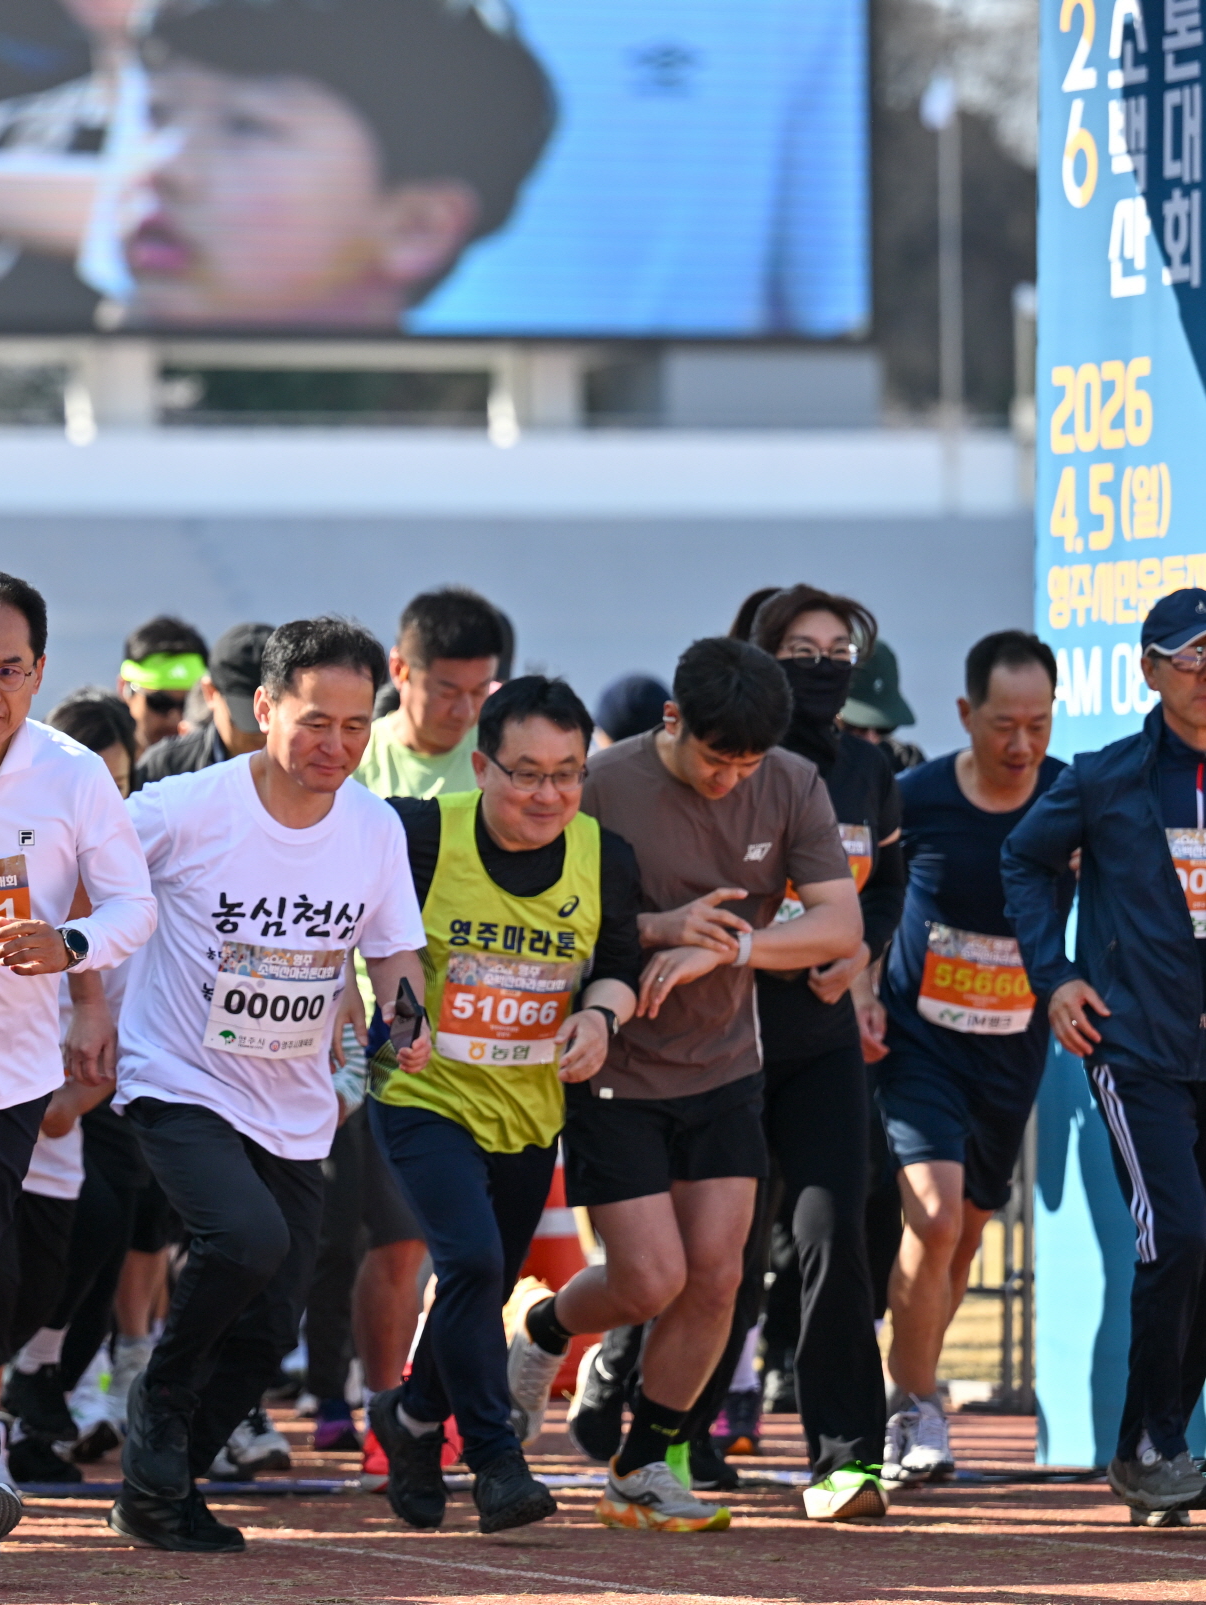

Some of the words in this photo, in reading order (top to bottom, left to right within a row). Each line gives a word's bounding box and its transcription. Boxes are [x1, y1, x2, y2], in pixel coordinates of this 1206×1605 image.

[1050, 356, 1154, 454] 2026
[1047, 553, 1206, 629] 영주시민운동
[1052, 645, 1103, 717] AM
[211, 892, 365, 940] 농심천심
[449, 919, 576, 958] 영주마라톤
[257, 964, 336, 980] 소백산마라톤대회
[262, 951, 293, 966] 2026
[293, 953, 313, 967] 영주
[224, 989, 325, 1022] 00000
[451, 992, 559, 1026] 51066
[491, 1044, 531, 1061] 농협
